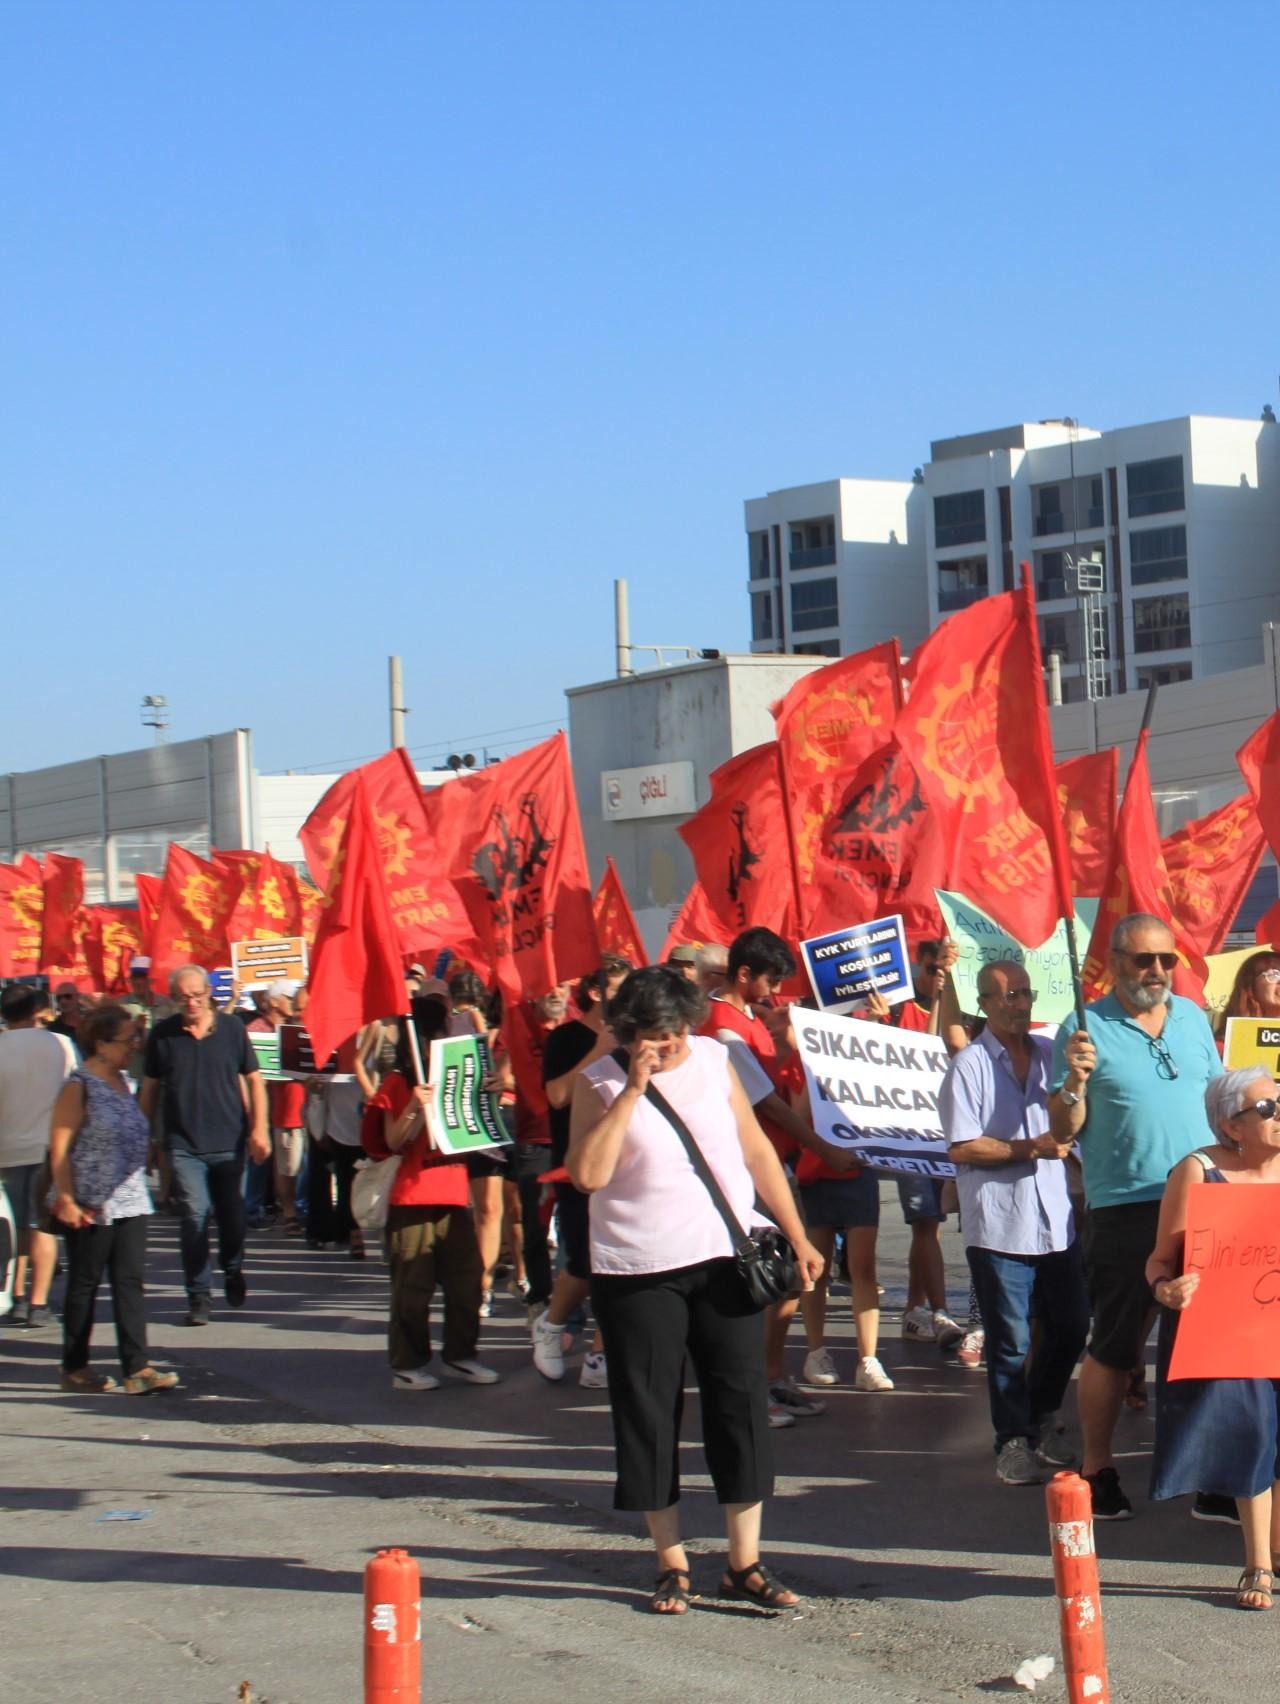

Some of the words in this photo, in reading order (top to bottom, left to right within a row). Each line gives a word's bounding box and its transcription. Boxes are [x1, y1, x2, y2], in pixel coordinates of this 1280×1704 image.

[814, 945, 840, 959] KYK
[802, 1027, 923, 1071] SIKACAK
[1187, 1228, 1238, 1270] Elini
